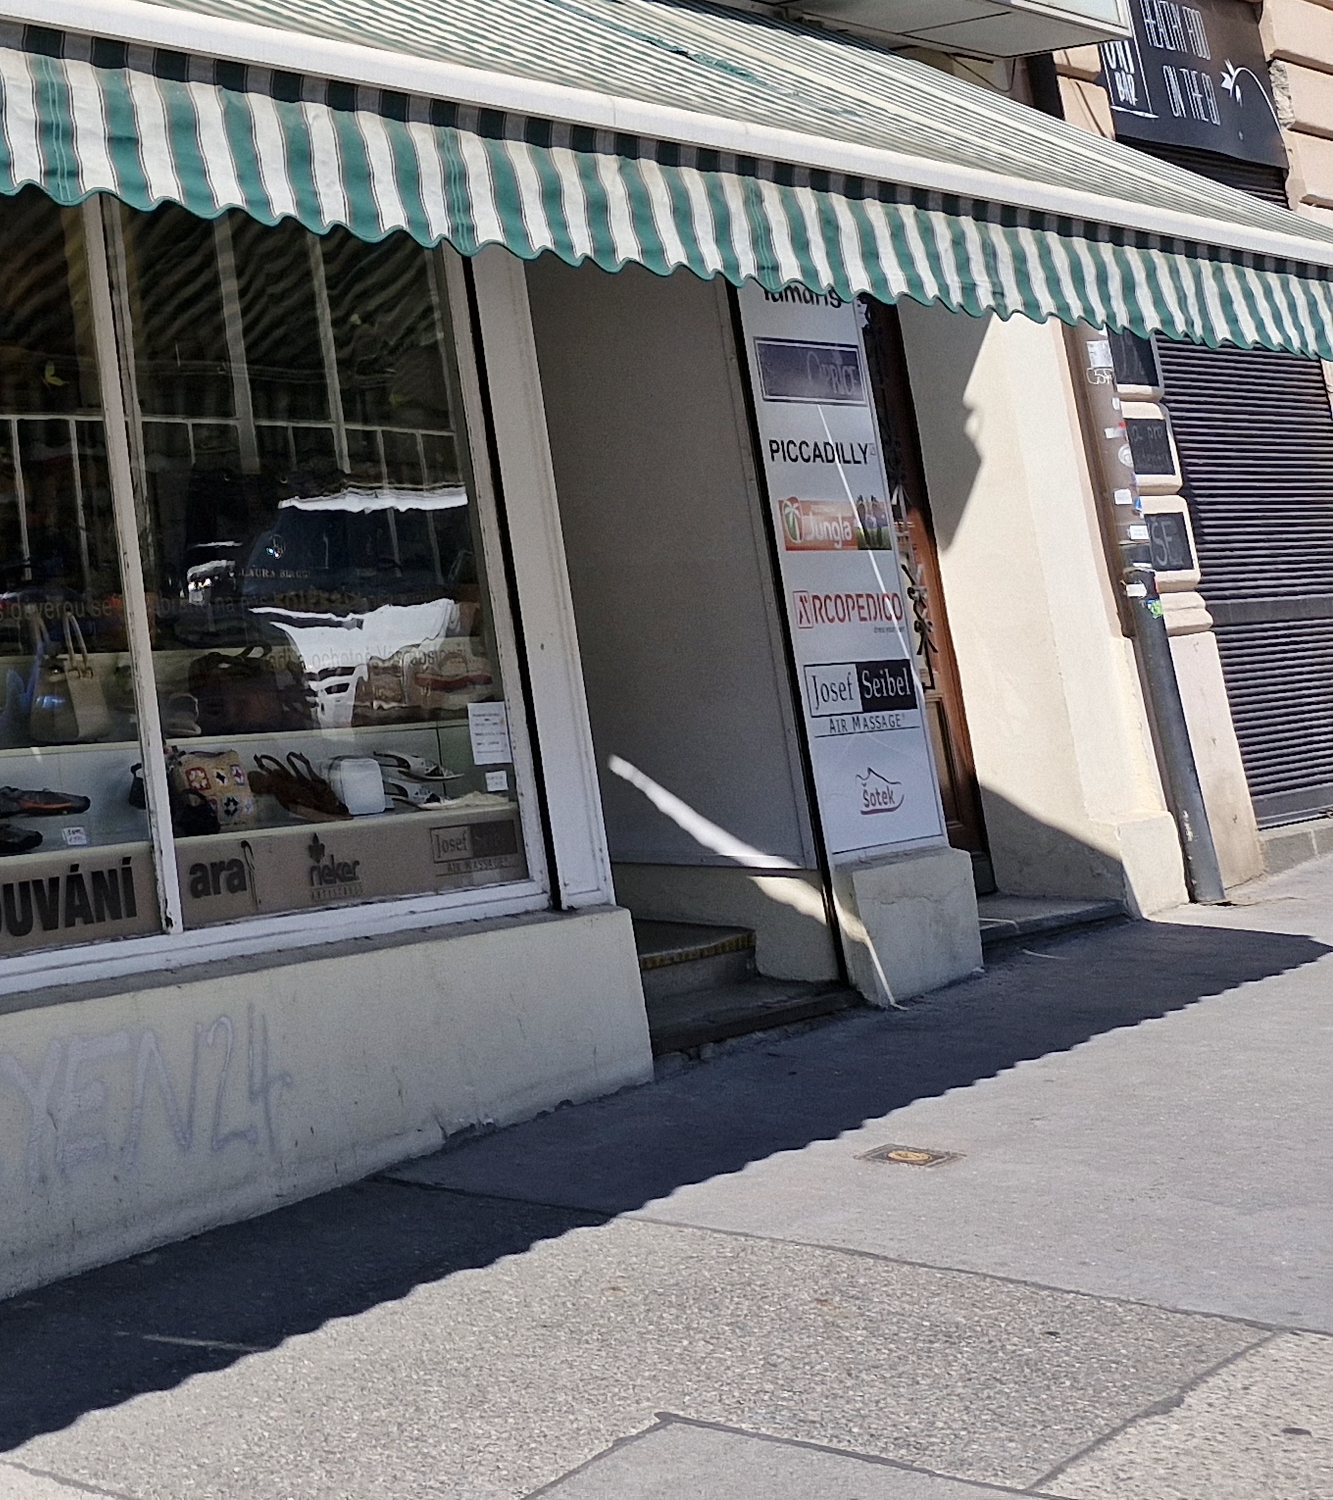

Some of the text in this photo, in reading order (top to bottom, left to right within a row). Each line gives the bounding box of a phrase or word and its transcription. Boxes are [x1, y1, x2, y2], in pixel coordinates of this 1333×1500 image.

[768, 438, 869, 465] PICCADILLY
[811, 667, 911, 710] Josef Seibel
[829, 714, 902, 734] AIR MASSAGE
[861, 781, 896, 809] Šotek
[307, 853, 361, 887] rieker
[435, 831, 469, 858] Josef
